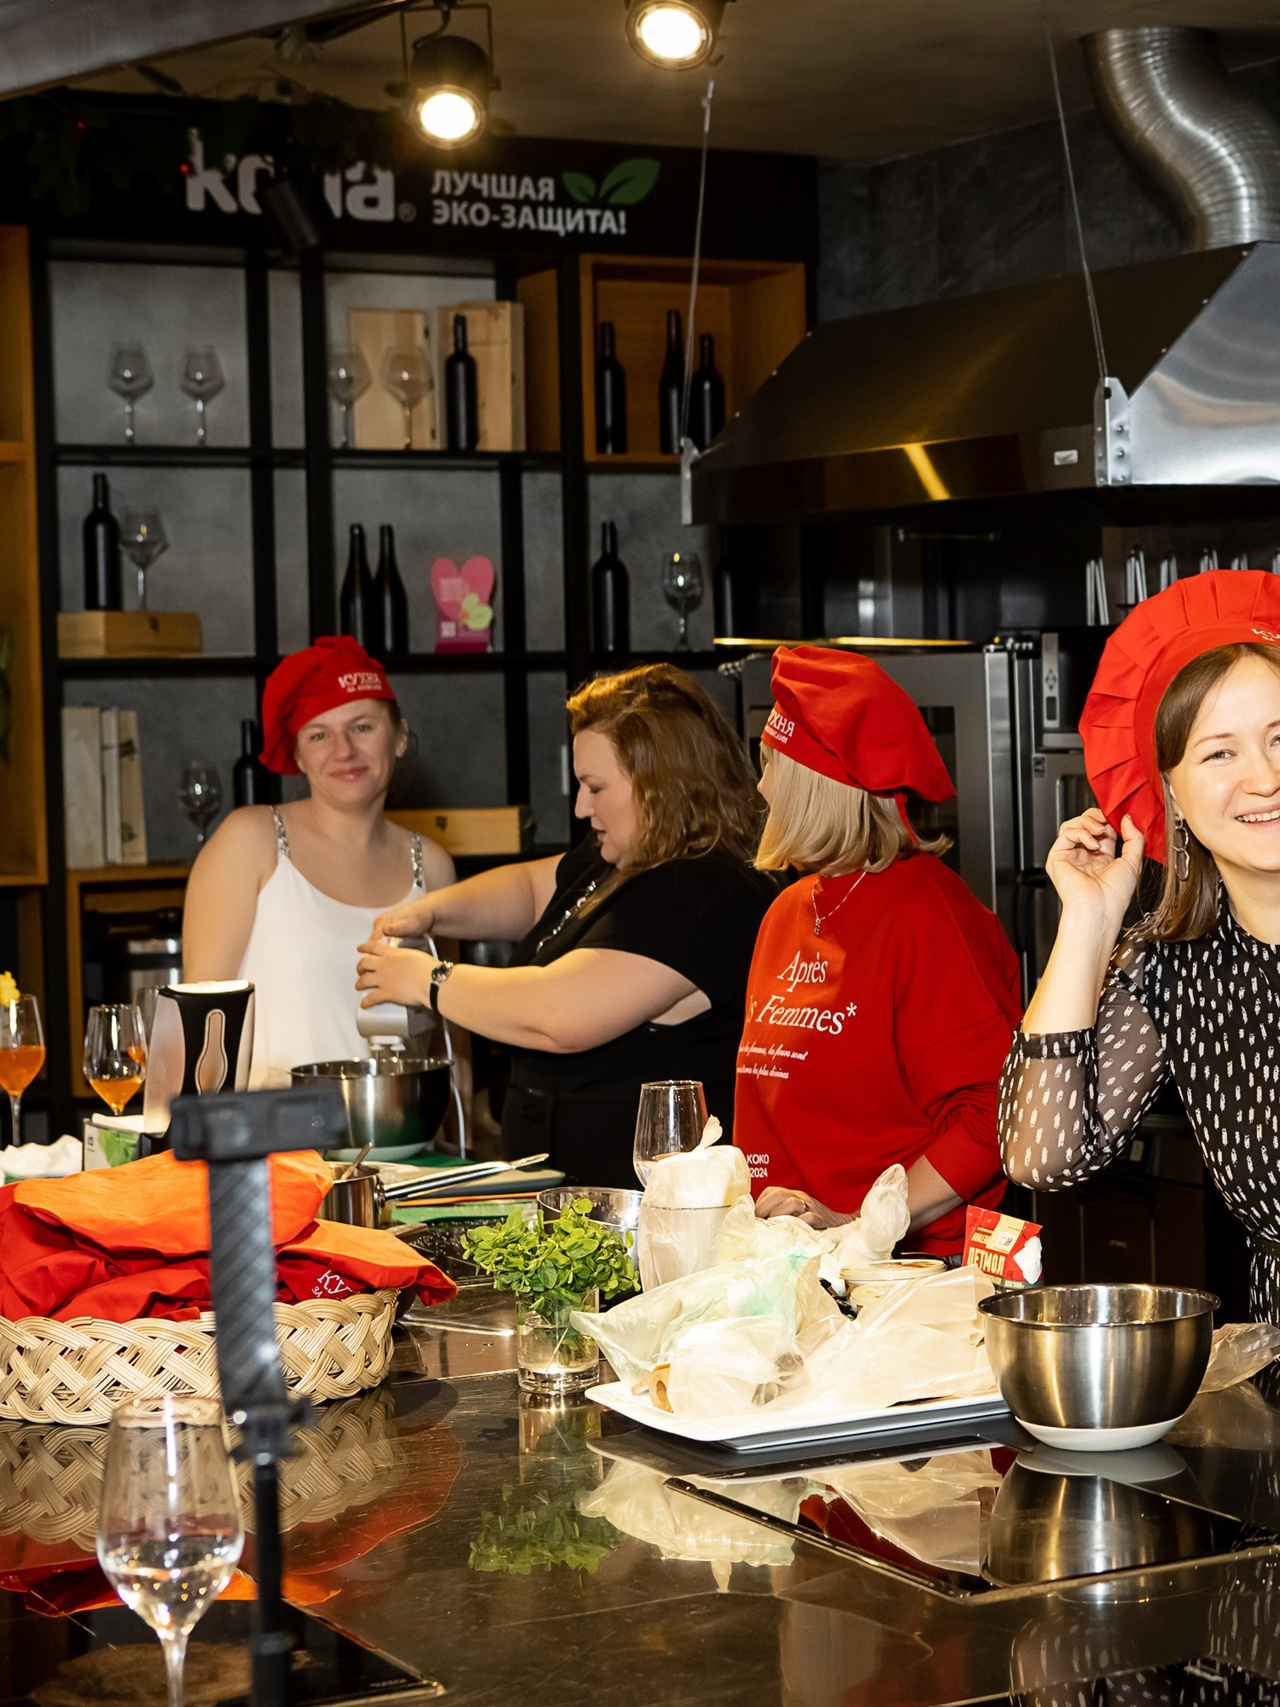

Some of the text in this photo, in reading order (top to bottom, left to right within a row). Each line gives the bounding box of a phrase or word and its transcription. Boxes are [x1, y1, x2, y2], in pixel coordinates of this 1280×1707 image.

[431, 169, 556, 202] ЛУЧШАЯ
[431, 199, 628, 237] ЭКО-ЗАЩИТА!
[777, 950, 829, 993] Après
[750, 1167, 768, 1178] 2024
